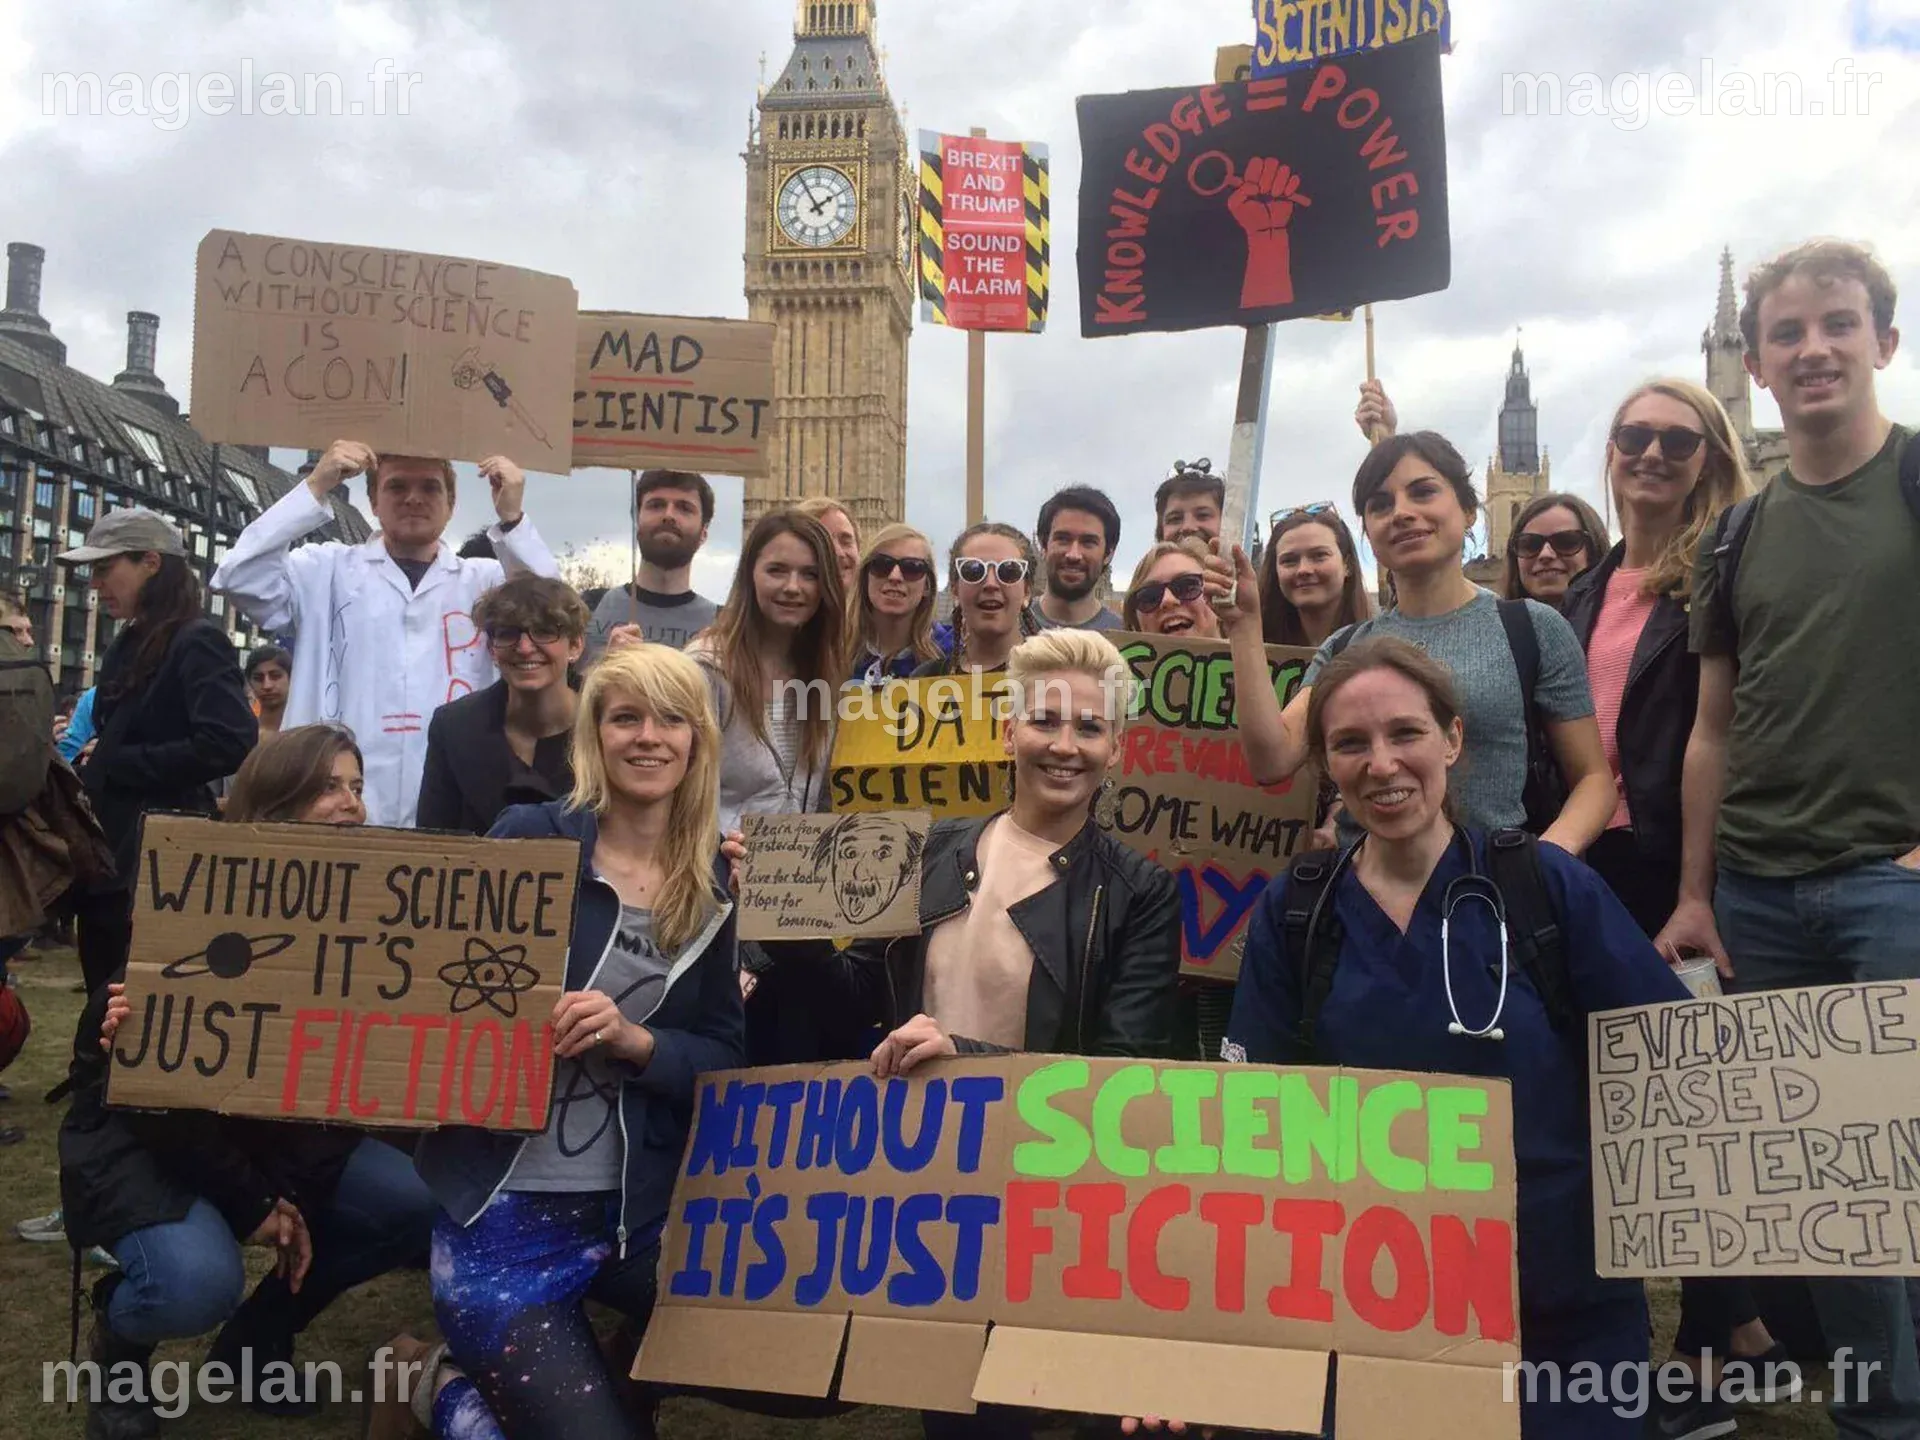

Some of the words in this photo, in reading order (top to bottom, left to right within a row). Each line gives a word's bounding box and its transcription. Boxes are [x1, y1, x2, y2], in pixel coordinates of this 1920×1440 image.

[946, 148, 1020, 173] BREXIT
[962, 173, 1006, 193] AND
[947, 193, 1021, 214] TRUMP
[1094, 84, 1233, 323] KNOWLEDGE
[1301, 64, 1420, 249] POWER
[217, 236, 247, 273] A
[264, 242, 499, 301] CONSCIENCE
[946, 233, 1021, 253] SOUND
[963, 256, 1005, 274] THE
[214, 278, 384, 316] WITHOUT
[392, 293, 536, 344] SCIENCE
[947, 277, 1022, 296] ALARM
[302, 322, 341, 351] IS
[589, 329, 704, 374] MAD
[240, 355, 272, 397] A
[325, 600, 352, 725] KNO
[1088, 786, 1201, 840] COME
[1211, 805, 1309, 858] WHAT
[147, 849, 361, 924] WITHOUT
[378, 864, 564, 938] SCIENCE
[780, 891, 803, 911] for
[787, 866, 829, 893] today
[313, 932, 415, 1000] IT'S
[115, 993, 281, 1079] JUST
[280, 1007, 554, 1130] FICTION
[1596, 985, 1918, 1074] EVIDENCE
[686, 1075, 1004, 1177] WITHOUT
[1012, 1060, 1494, 1193] SCIENCE
[1599, 1066, 1820, 1135] BASED
[670, 1172, 789, 1301] IT'S
[794, 1190, 1002, 1307] JUST
[1004, 1181, 1517, 1343] FICTION
[1609, 1200, 1920, 1269] MEDICI
